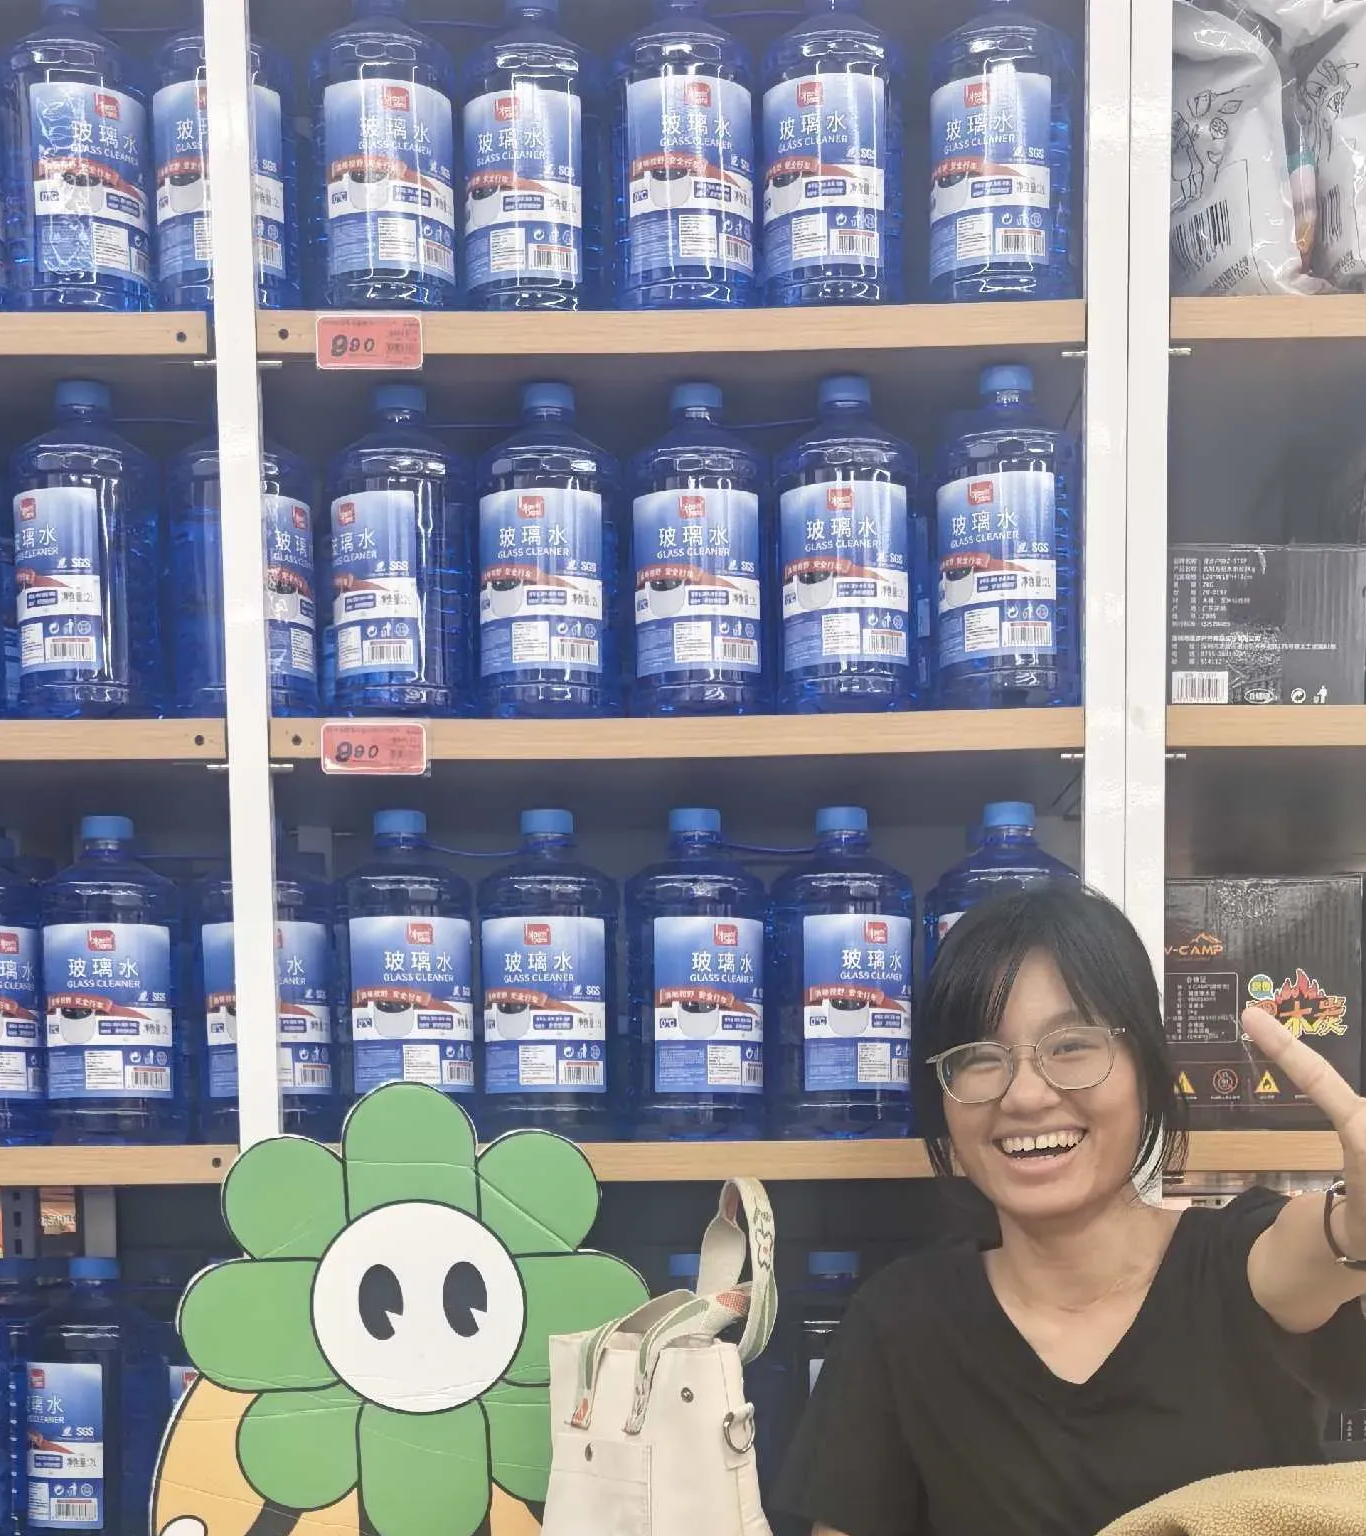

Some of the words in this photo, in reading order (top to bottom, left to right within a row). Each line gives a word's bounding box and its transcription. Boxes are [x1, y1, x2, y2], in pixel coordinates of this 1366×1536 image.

[360, 117, 431, 144] 玻璃水
[661, 113, 732, 139] 玻璃水
[779, 109, 848, 141] 玻璃水
[945, 111, 1015, 142] 玻璃水
[71, 120, 139, 155] 玻璃水
[478, 127, 543, 154] 玻璃水
[861, 147, 875, 160] SGS
[1028, 147, 1044, 159] SGS
[558, 165, 575, 177] SGS
[951, 506, 1018, 536] 玻璃水
[806, 516, 876, 540] 玻璃水
[499, 524, 568, 547] 玻璃水
[658, 524, 729, 548] 玻璃水
[950, 535, 974, 549] GLASS
[975, 530, 1019, 542] CLEANER
[804, 541, 833, 553] GLASS
[835, 538, 879, 549] CLEANER
[1031, 541, 1049, 553] SGS
[497, 548, 524, 559] GLASS
[526, 546, 569, 557] CLEANER
[657, 548, 685, 559] GLASS
[687, 546, 730, 558] CLEANER
[889, 552, 903, 564] SGS
[71, 557, 91, 569] SGS
[580, 561, 597, 572] SGS
[741, 561, 754, 573] SGS
[1165, 944, 1224, 957] V-CAMP
[384, 950, 453, 972] 玻璃水
[505, 950, 573, 973] 玻璃水
[691, 950, 753, 973] 玻璃水
[842, 949, 902, 972] 玻璃水
[68, 957, 139, 979] 玻璃水
[383, 973, 414, 981] GLASS
[417, 973, 454, 982] CLEANER
[503, 973, 530, 983] GLASS
[532, 973, 574, 983] CLEANER
[690, 974, 719, 983] GLASS
[840, 971, 870, 981] GLASS
[66, 979, 94, 989] GLASS
[96, 979, 141, 989] CLEANER
[586, 985, 601, 996] SGS
[76, 1426, 94, 1437] SGS
